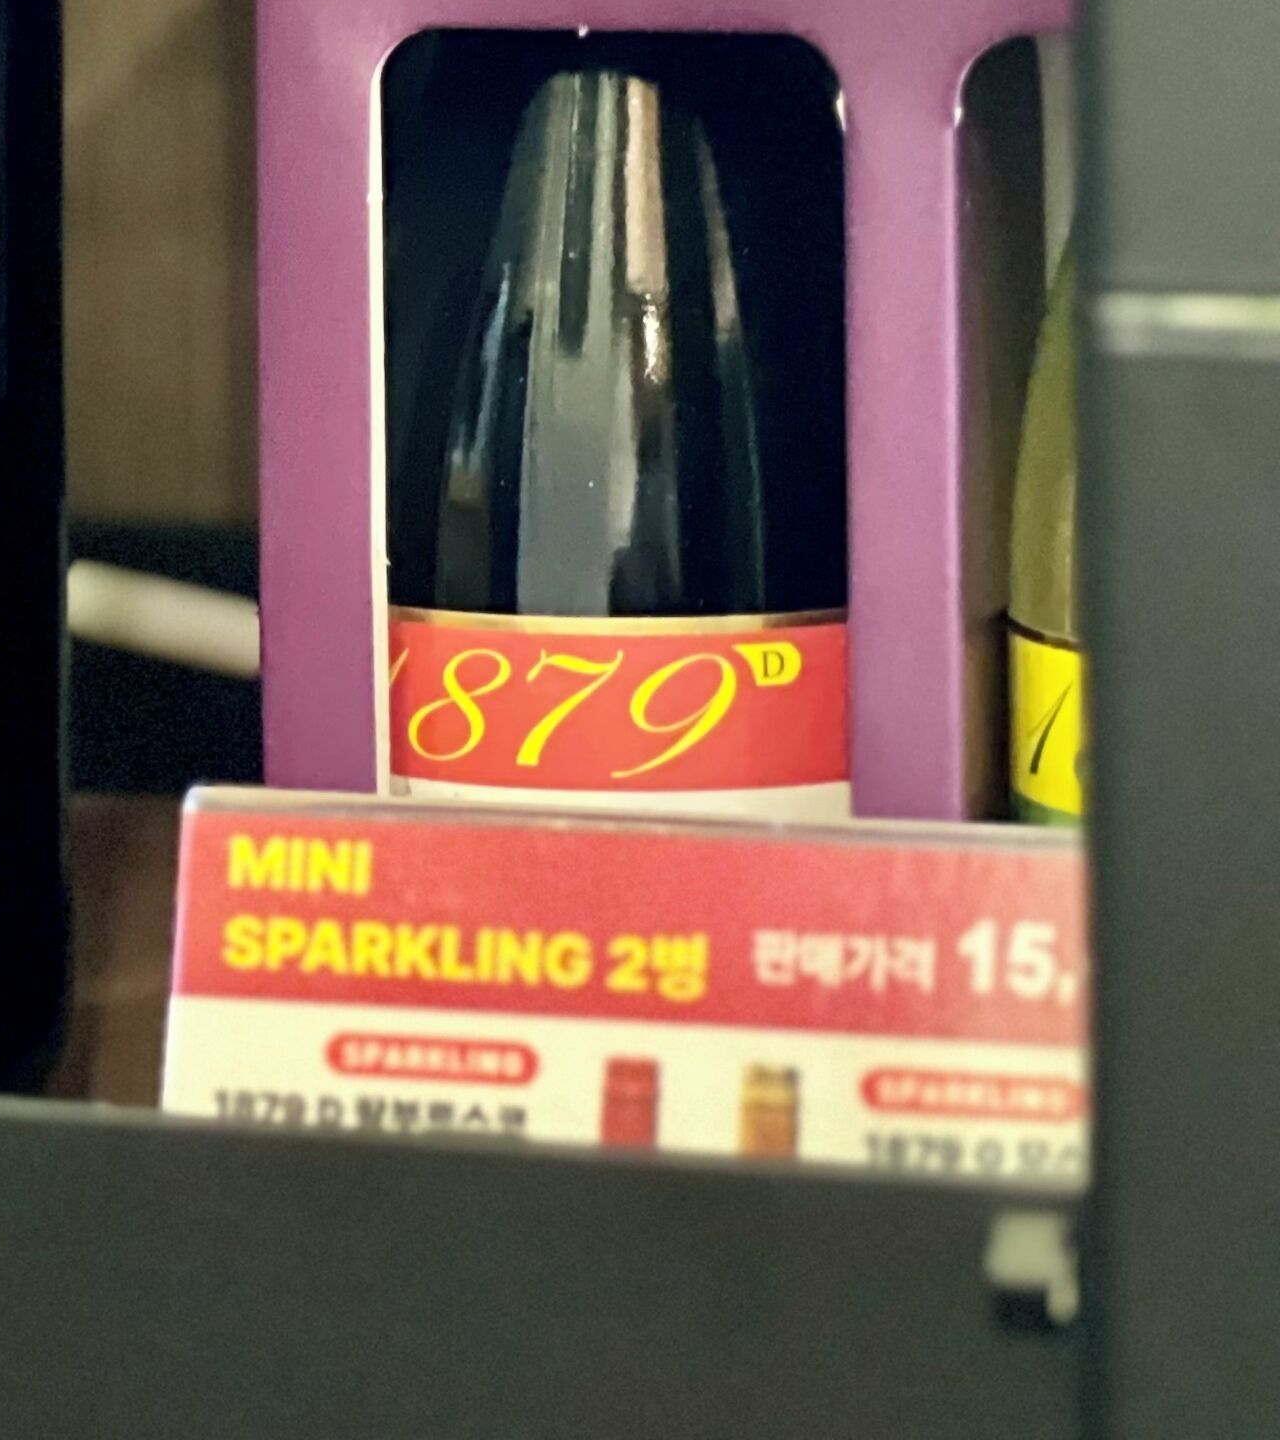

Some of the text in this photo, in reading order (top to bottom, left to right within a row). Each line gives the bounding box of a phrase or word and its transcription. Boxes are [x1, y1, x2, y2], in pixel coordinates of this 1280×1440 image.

[390, 647, 786, 778] 879 D
[228, 834, 373, 897] MINI
[222, 915, 709, 1002] SPARKLING 2병
[956, 916, 1080, 1008] 15,
